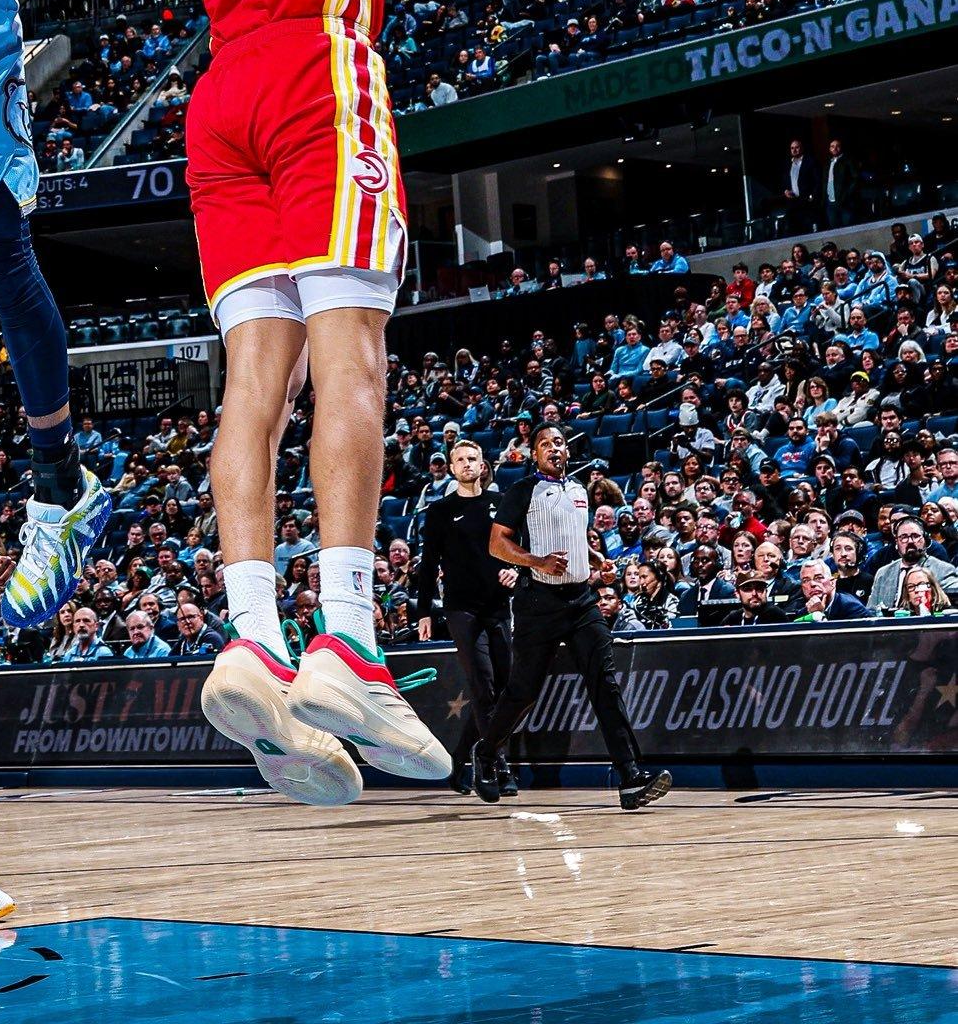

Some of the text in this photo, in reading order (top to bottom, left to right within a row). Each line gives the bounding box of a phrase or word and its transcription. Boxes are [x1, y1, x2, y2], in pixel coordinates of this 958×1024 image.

[79, 176, 88, 189] 4
[127, 166, 174, 200] 70
[54, 194, 64, 208] 2
[180, 345, 201, 359] 107
[20, 680, 116, 724] JUST
[119, 680, 142, 721] 7
[665, 664, 802, 731] CASINO
[795, 660, 908, 728] HOTEL
[13, 728, 71, 754] FROM
[75, 726, 210, 753] DOWNTOWN
